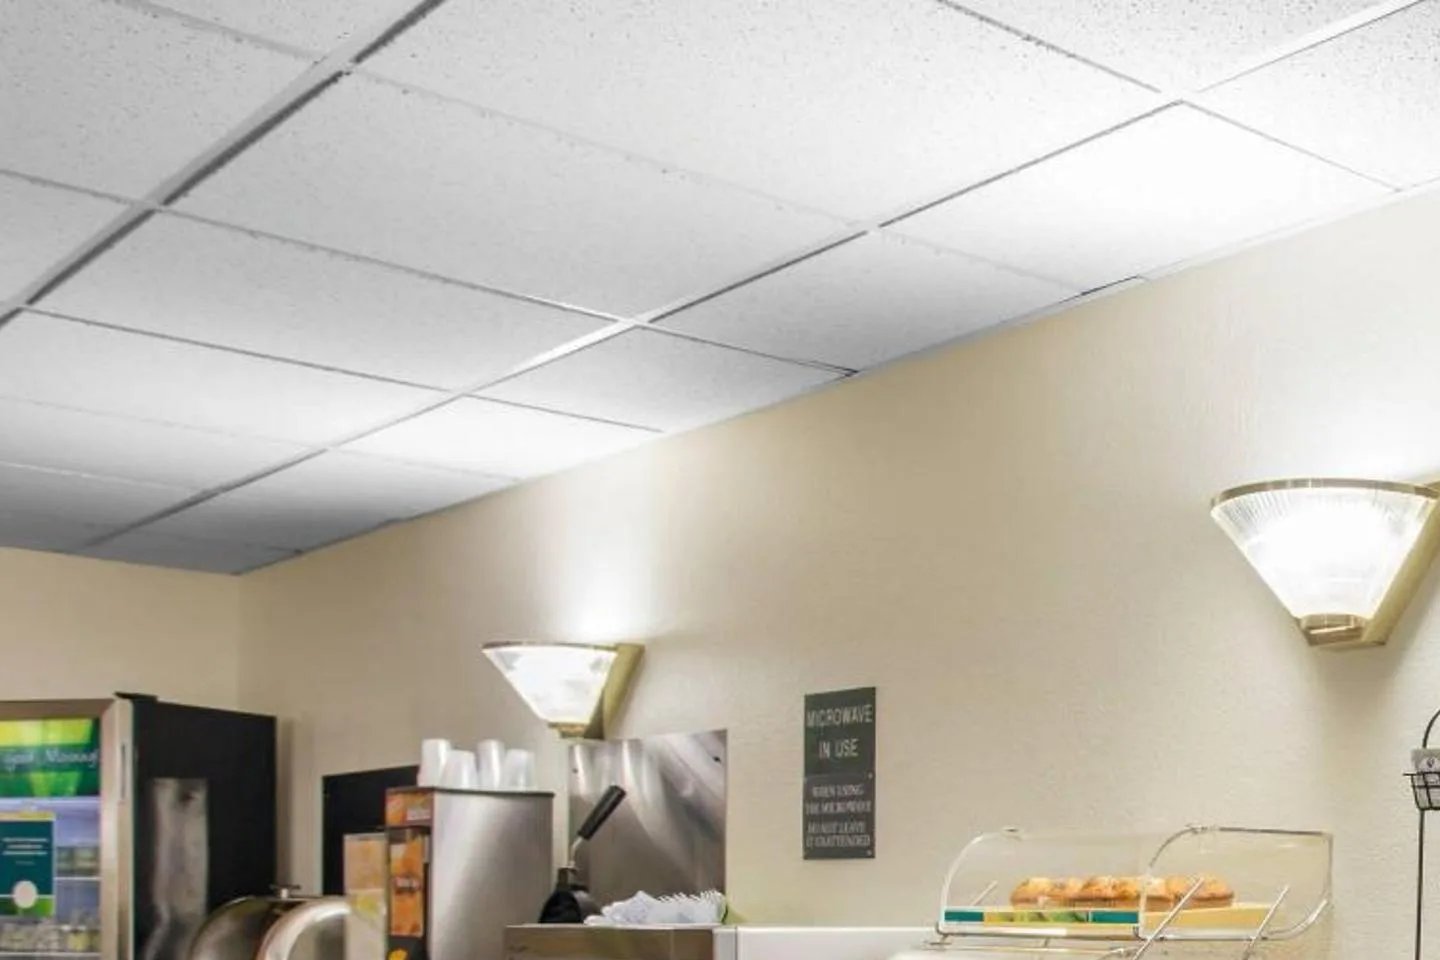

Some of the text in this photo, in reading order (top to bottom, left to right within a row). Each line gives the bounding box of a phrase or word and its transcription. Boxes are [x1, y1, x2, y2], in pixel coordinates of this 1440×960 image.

[806, 705, 873, 728] MICROWAVE
[819, 738, 859, 760] IN USE
